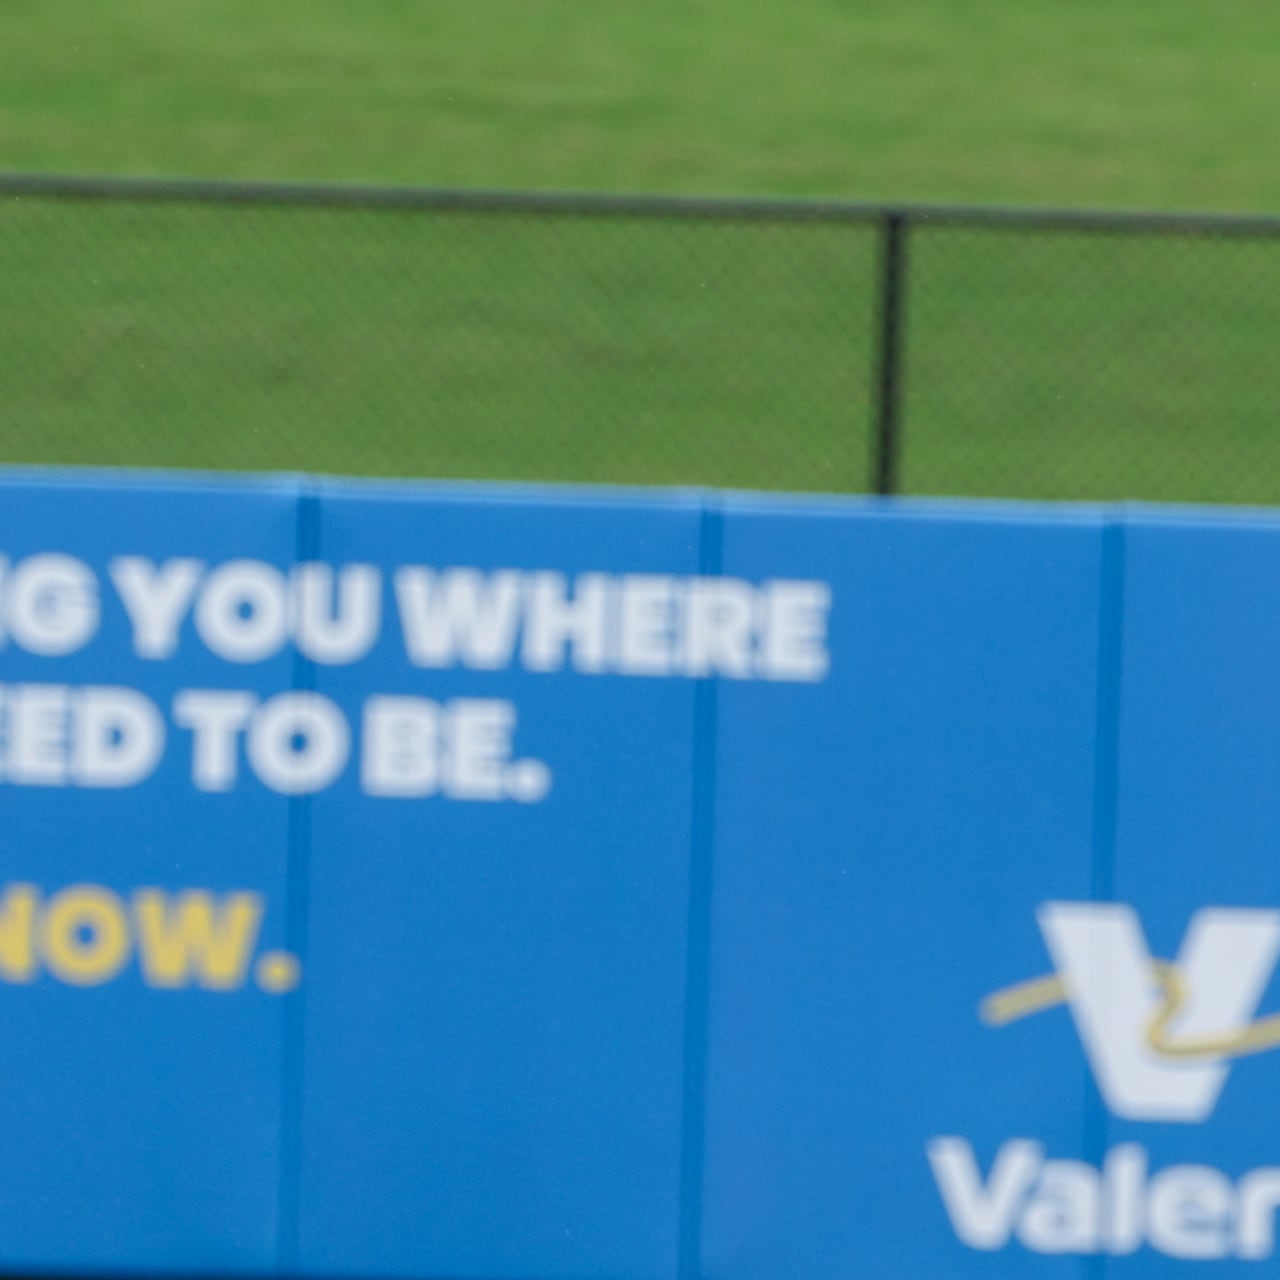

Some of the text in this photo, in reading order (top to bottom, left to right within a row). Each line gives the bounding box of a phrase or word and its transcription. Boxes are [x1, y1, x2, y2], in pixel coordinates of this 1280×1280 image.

[108, 554, 383, 666] YOU
[394, 563, 832, 683] WHERE
[0, 681, 553, 803] ED TO BE.
